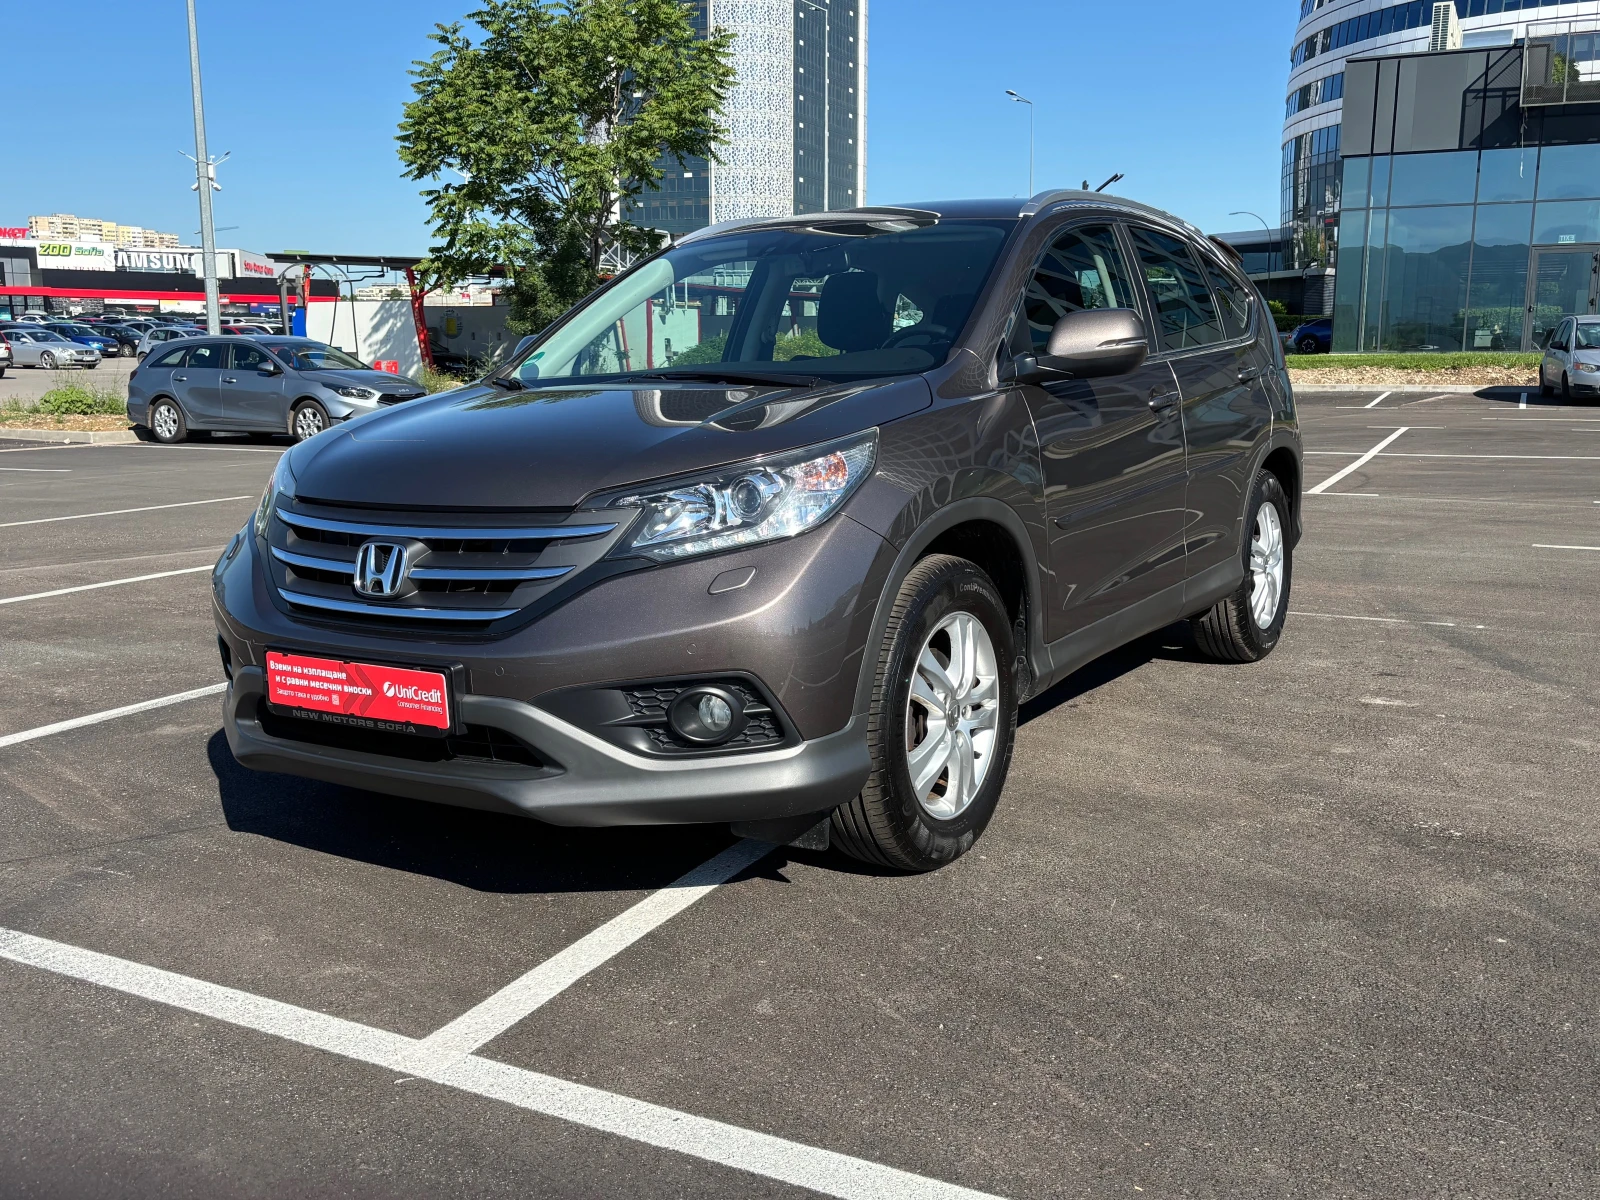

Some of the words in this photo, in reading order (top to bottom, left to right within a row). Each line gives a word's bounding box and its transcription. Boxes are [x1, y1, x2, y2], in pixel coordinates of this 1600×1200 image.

[39, 243, 72, 256] ZOO
[74, 246, 104, 256] Sofia
[269, 660, 291, 671] Вземи
[293, 665, 302, 673] на
[303, 667, 346, 680] изплащане
[286, 677, 309, 686] равни
[310, 680, 342, 692] месечни
[343, 685, 372, 696] вноски
[395, 683, 442, 704] UniCredit
[311, 693, 330, 702] удобно
[396, 700, 420, 710] Consumer
[420, 703, 443, 715] Financing
[292, 709, 319, 720] NEW
[322, 714, 374, 728] MOTORS
[377, 721, 416, 734] SOFIA
